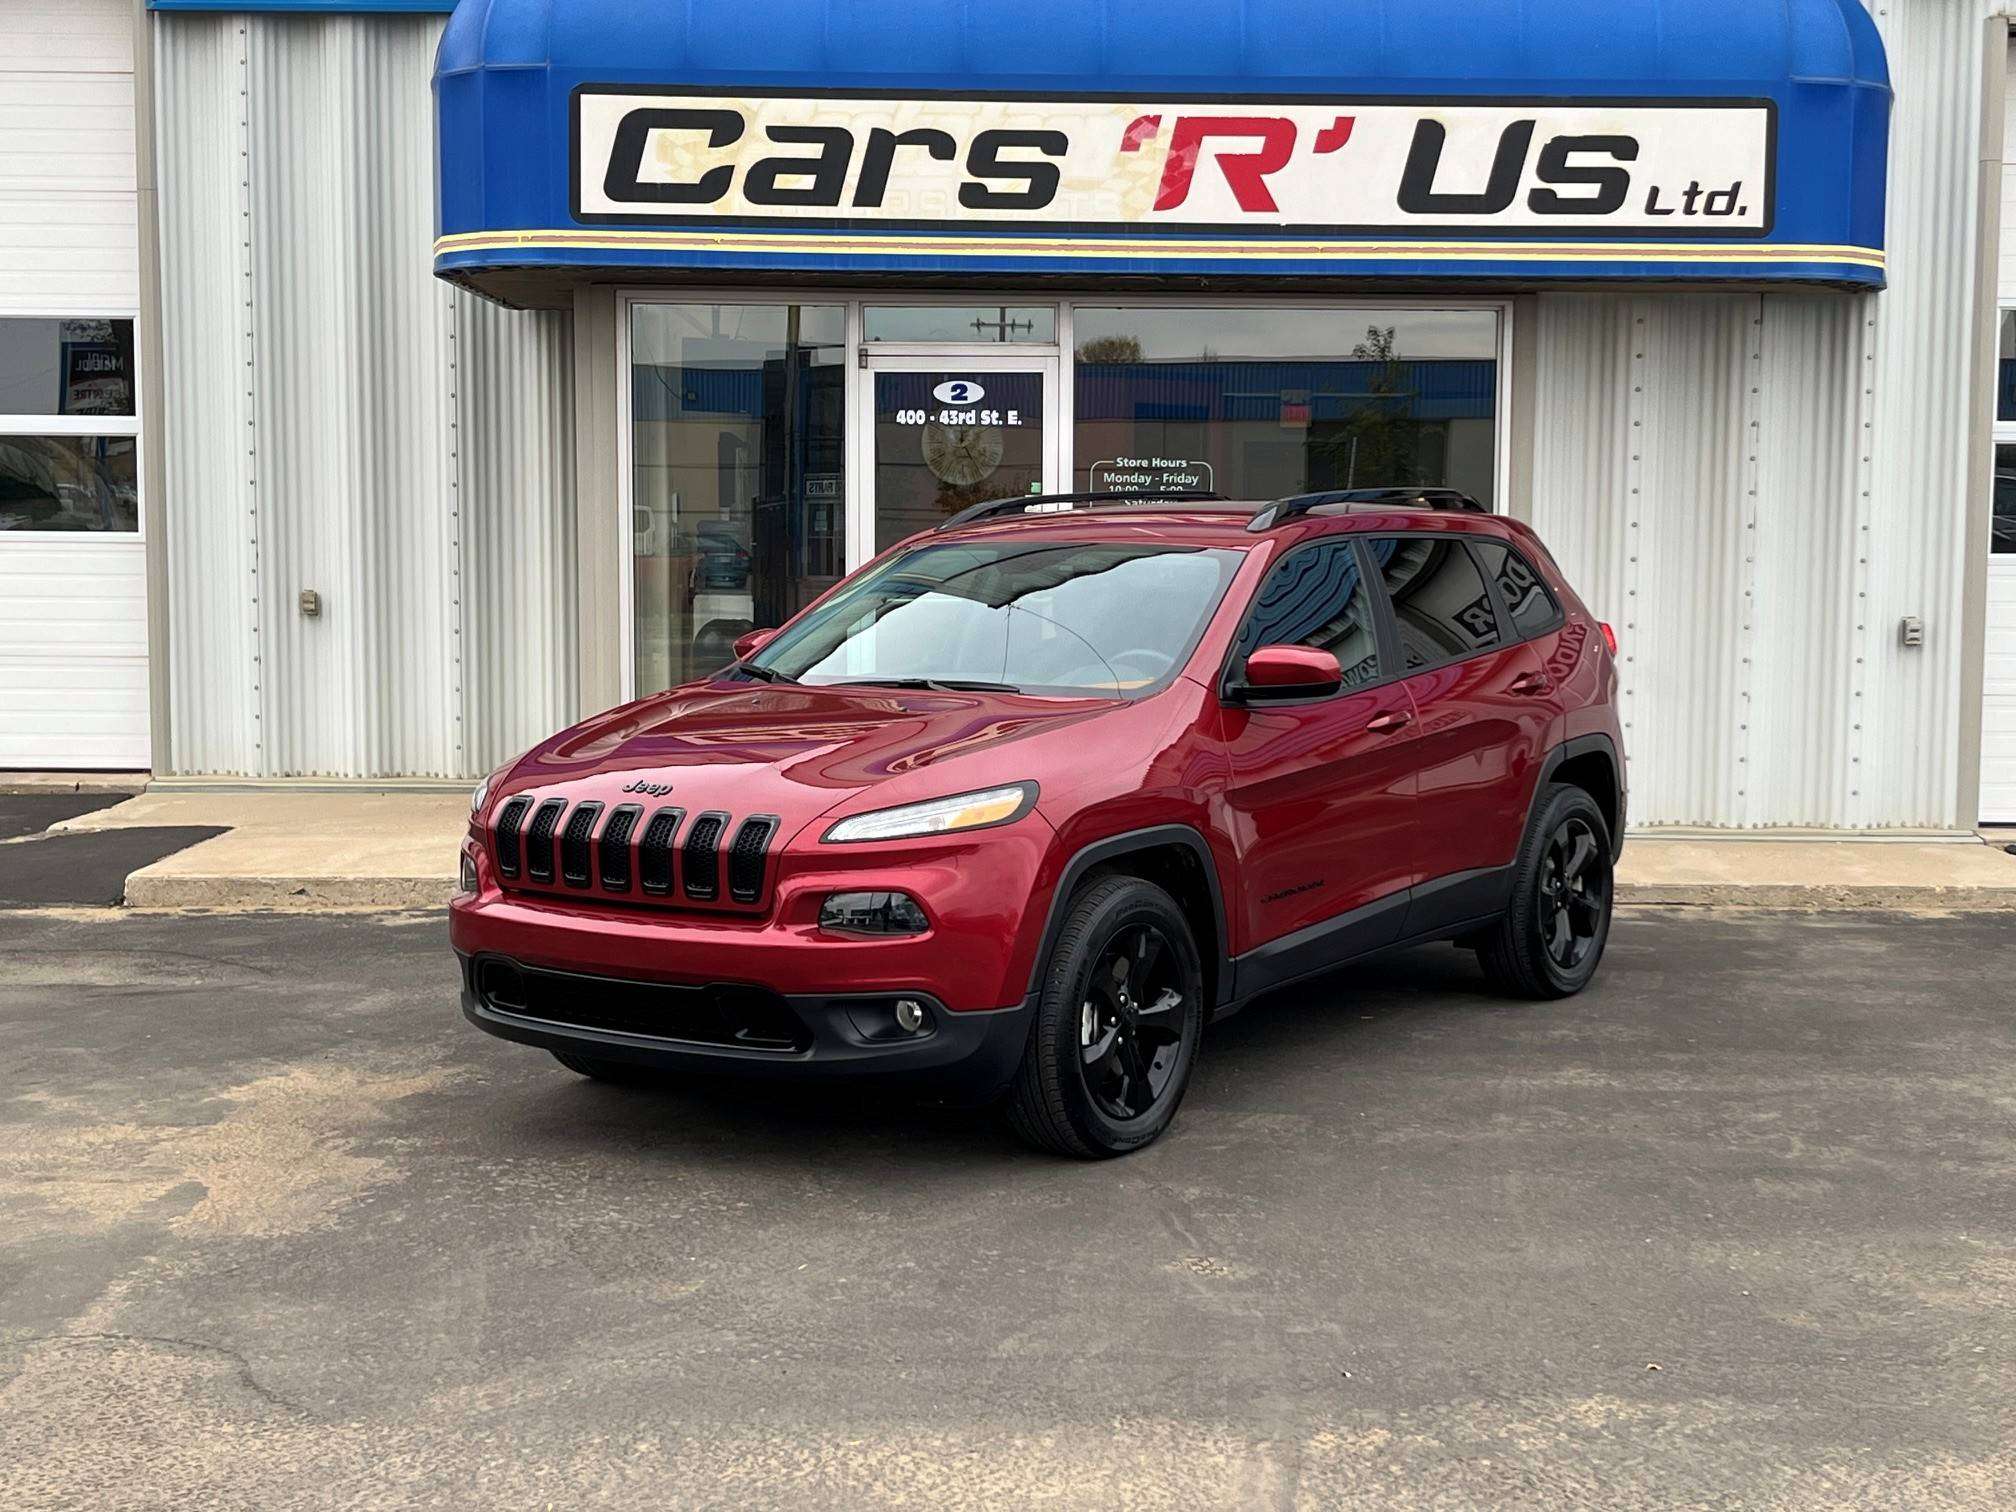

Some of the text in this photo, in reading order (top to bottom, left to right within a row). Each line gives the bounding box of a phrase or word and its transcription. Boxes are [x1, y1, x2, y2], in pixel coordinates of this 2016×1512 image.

[603, 107, 1069, 210] Cars
[1396, 118, 1639, 215] Us
[1644, 180, 1748, 215] Ltd.
[950, 383, 968, 401] 2
[896, 410, 926, 425] 400
[939, 410, 976, 425] 43rd
[980, 410, 1003, 425] St.
[1007, 410, 1022, 425] E.
[1116, 457, 1187, 468] Store Hours
[1103, 472, 1152, 486] Monday
[1163, 473, 1200, 486] Friday
[622, 780, 673, 798] Jeep
